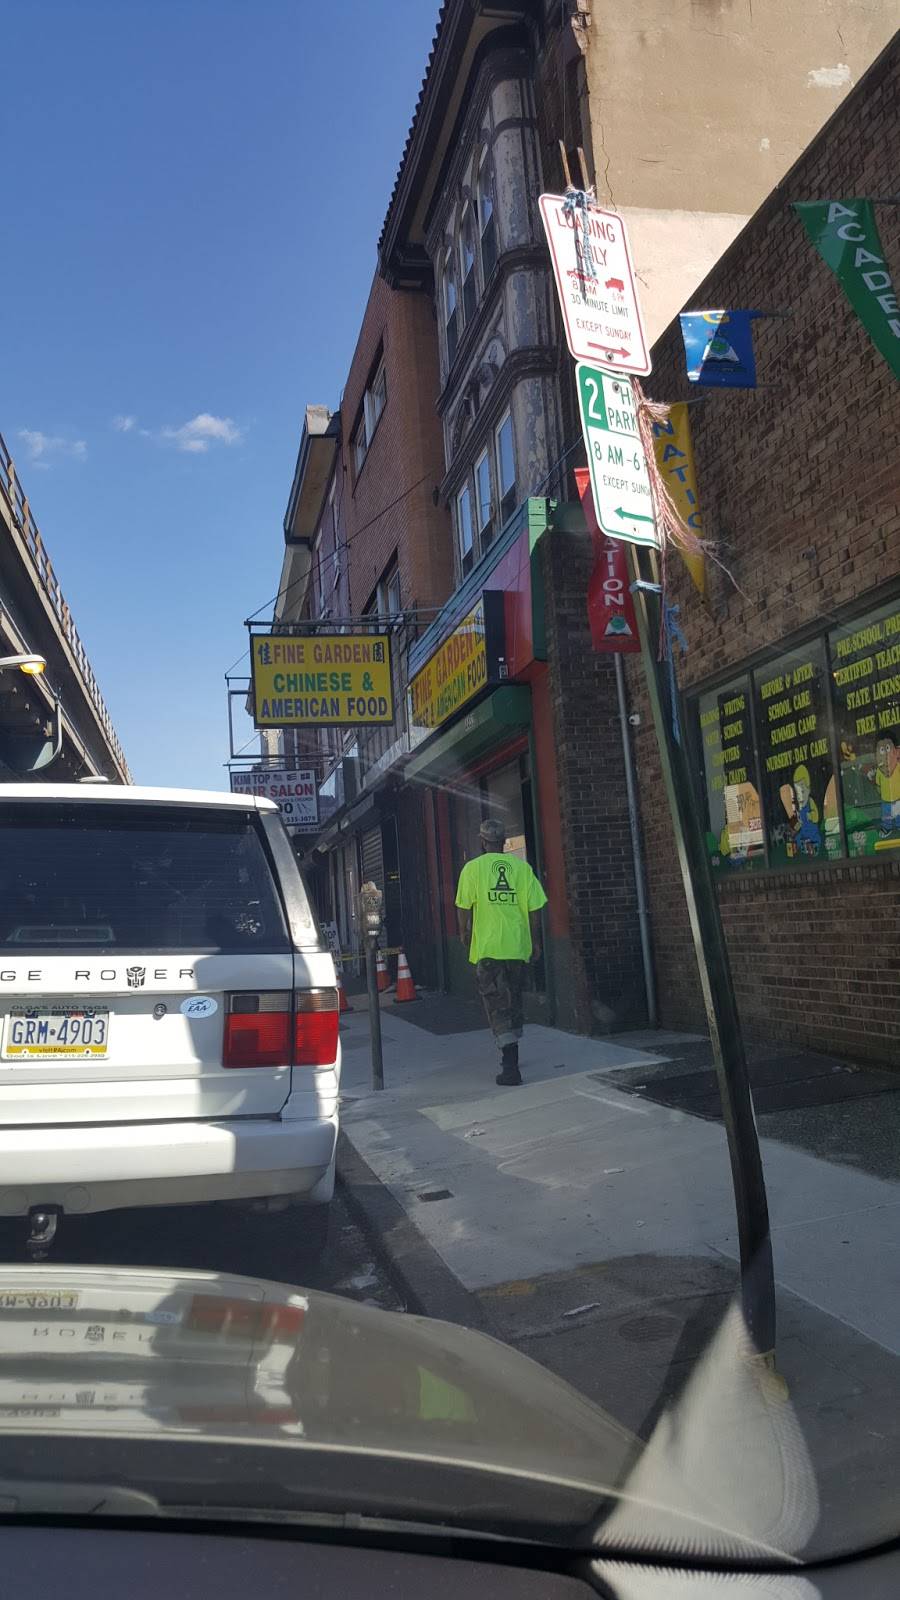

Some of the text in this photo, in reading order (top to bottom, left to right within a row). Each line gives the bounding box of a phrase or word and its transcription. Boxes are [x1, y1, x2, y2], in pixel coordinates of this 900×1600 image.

[570, 293, 582, 305] 30
[611, 304, 629, 318] LIMIT
[576, 318, 632, 341] EXCEPT SUNDAY
[585, 377, 602, 421] 2
[594, 440, 602, 461] 8
[602, 474, 629, 492] EXCEPT
[273, 643, 371, 664] FINE GARDEN
[436, 632, 473, 685] GARDEN
[273, 671, 374, 693] CHINESE &
[467, 650, 487, 692] FOOD
[761, 676, 784, 701] BEFORE
[793, 662, 815, 687] AFTER
[835, 656, 874, 687] CERTIFIED
[260, 698, 341, 719] AMERICAN
[347, 695, 388, 717] FOOD
[768, 690, 812, 722] SCHOOL CARE
[847, 686, 871, 712] STATE
[770, 714, 817, 747] SUMMER CAMP
[856, 714, 876, 737] FREE
[810, 737, 830, 759] CARE
[233, 774, 251, 785] KIM
[253, 773, 270, 784] TOP
[270, 783, 314, 797] SALON
[488, 892, 517, 903] UCT
